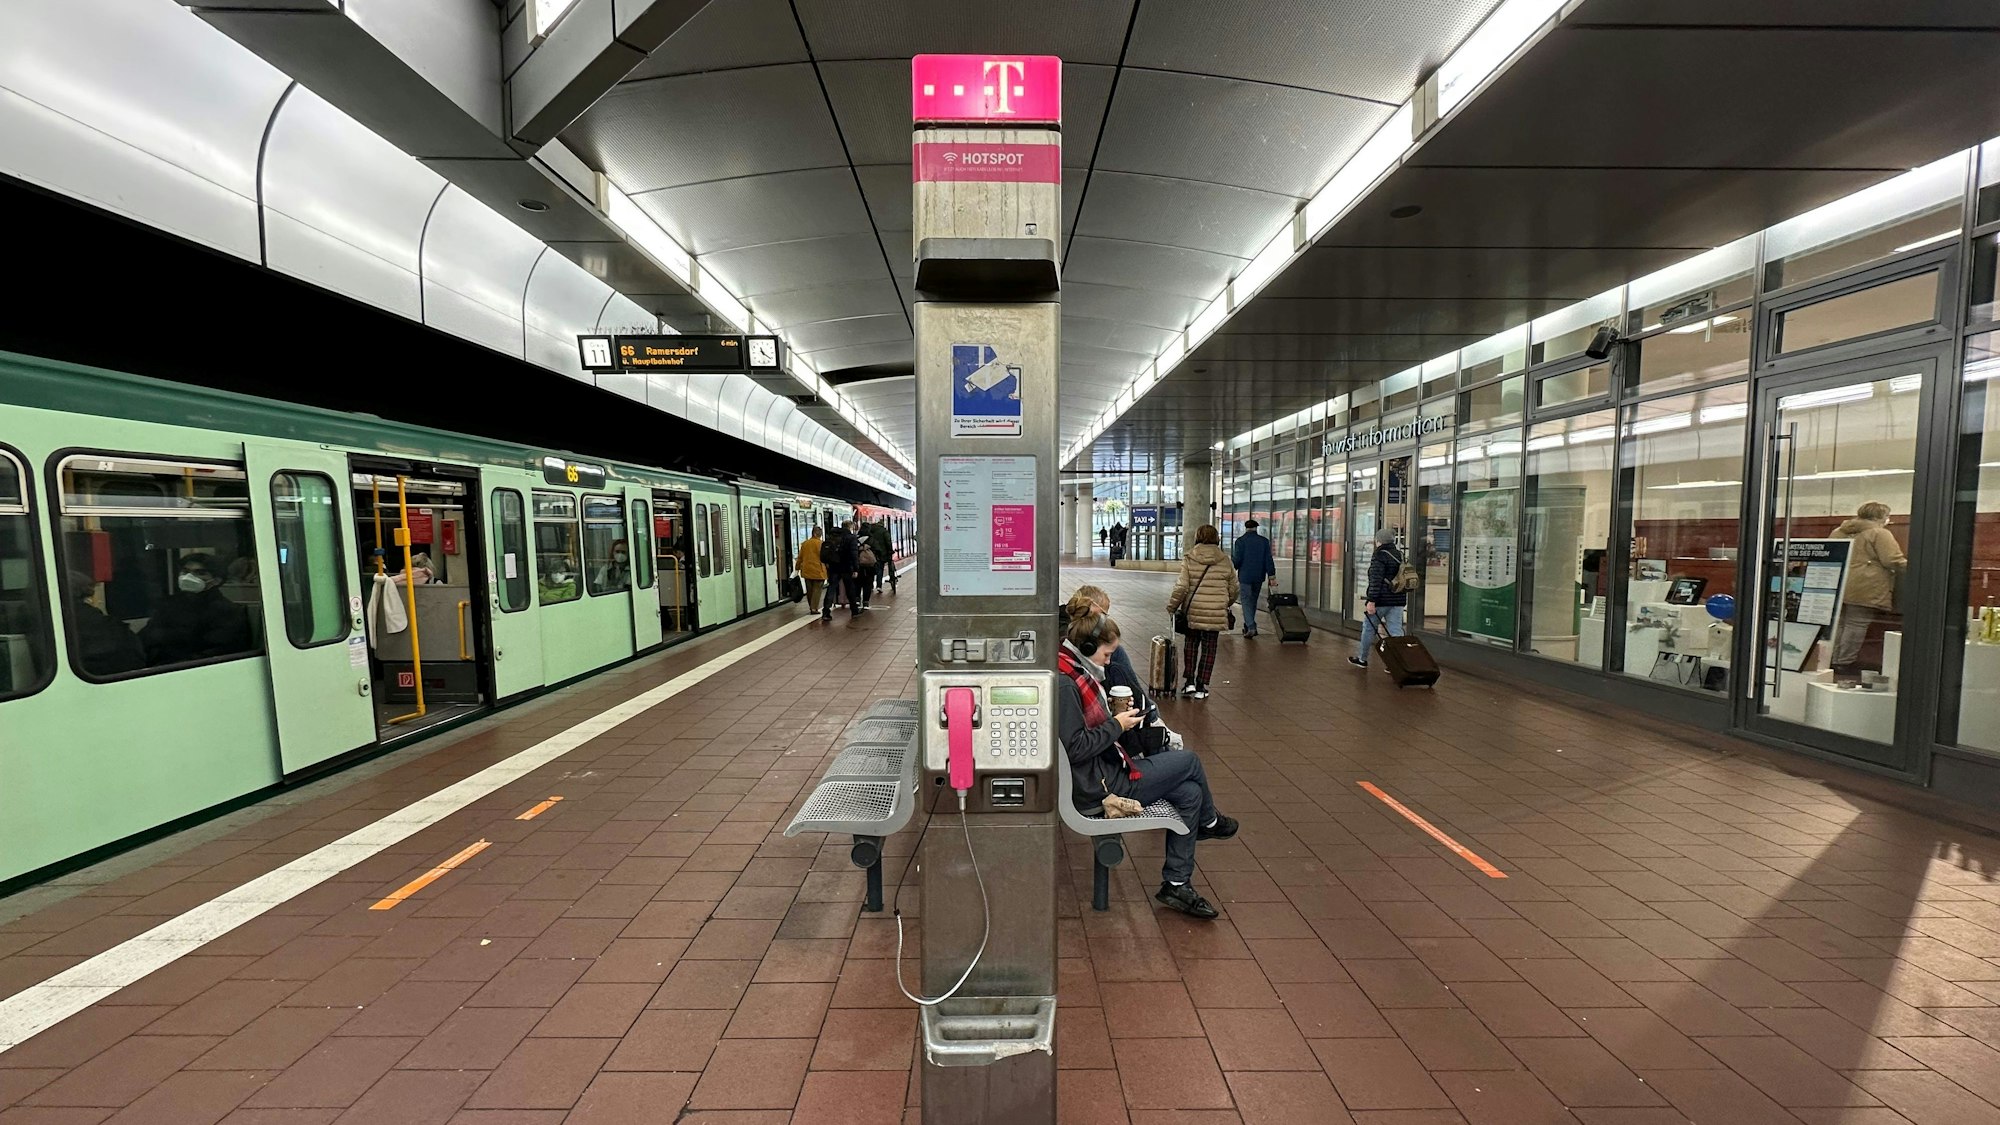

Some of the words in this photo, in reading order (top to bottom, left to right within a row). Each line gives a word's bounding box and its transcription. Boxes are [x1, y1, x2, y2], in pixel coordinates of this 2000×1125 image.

[983, 61, 1025, 114] T
[962, 152, 1024, 165] HOTSPOT
[591, 349, 606, 364] 11
[620, 345, 635, 356] 66
[646, 346, 699, 356] Ramersdorf
[632, 358, 685, 366] Hauptbahnhof
[1322, 432, 1356, 457] tourist
[1358, 415, 1443, 450] information
[567, 465, 578, 482] 66
